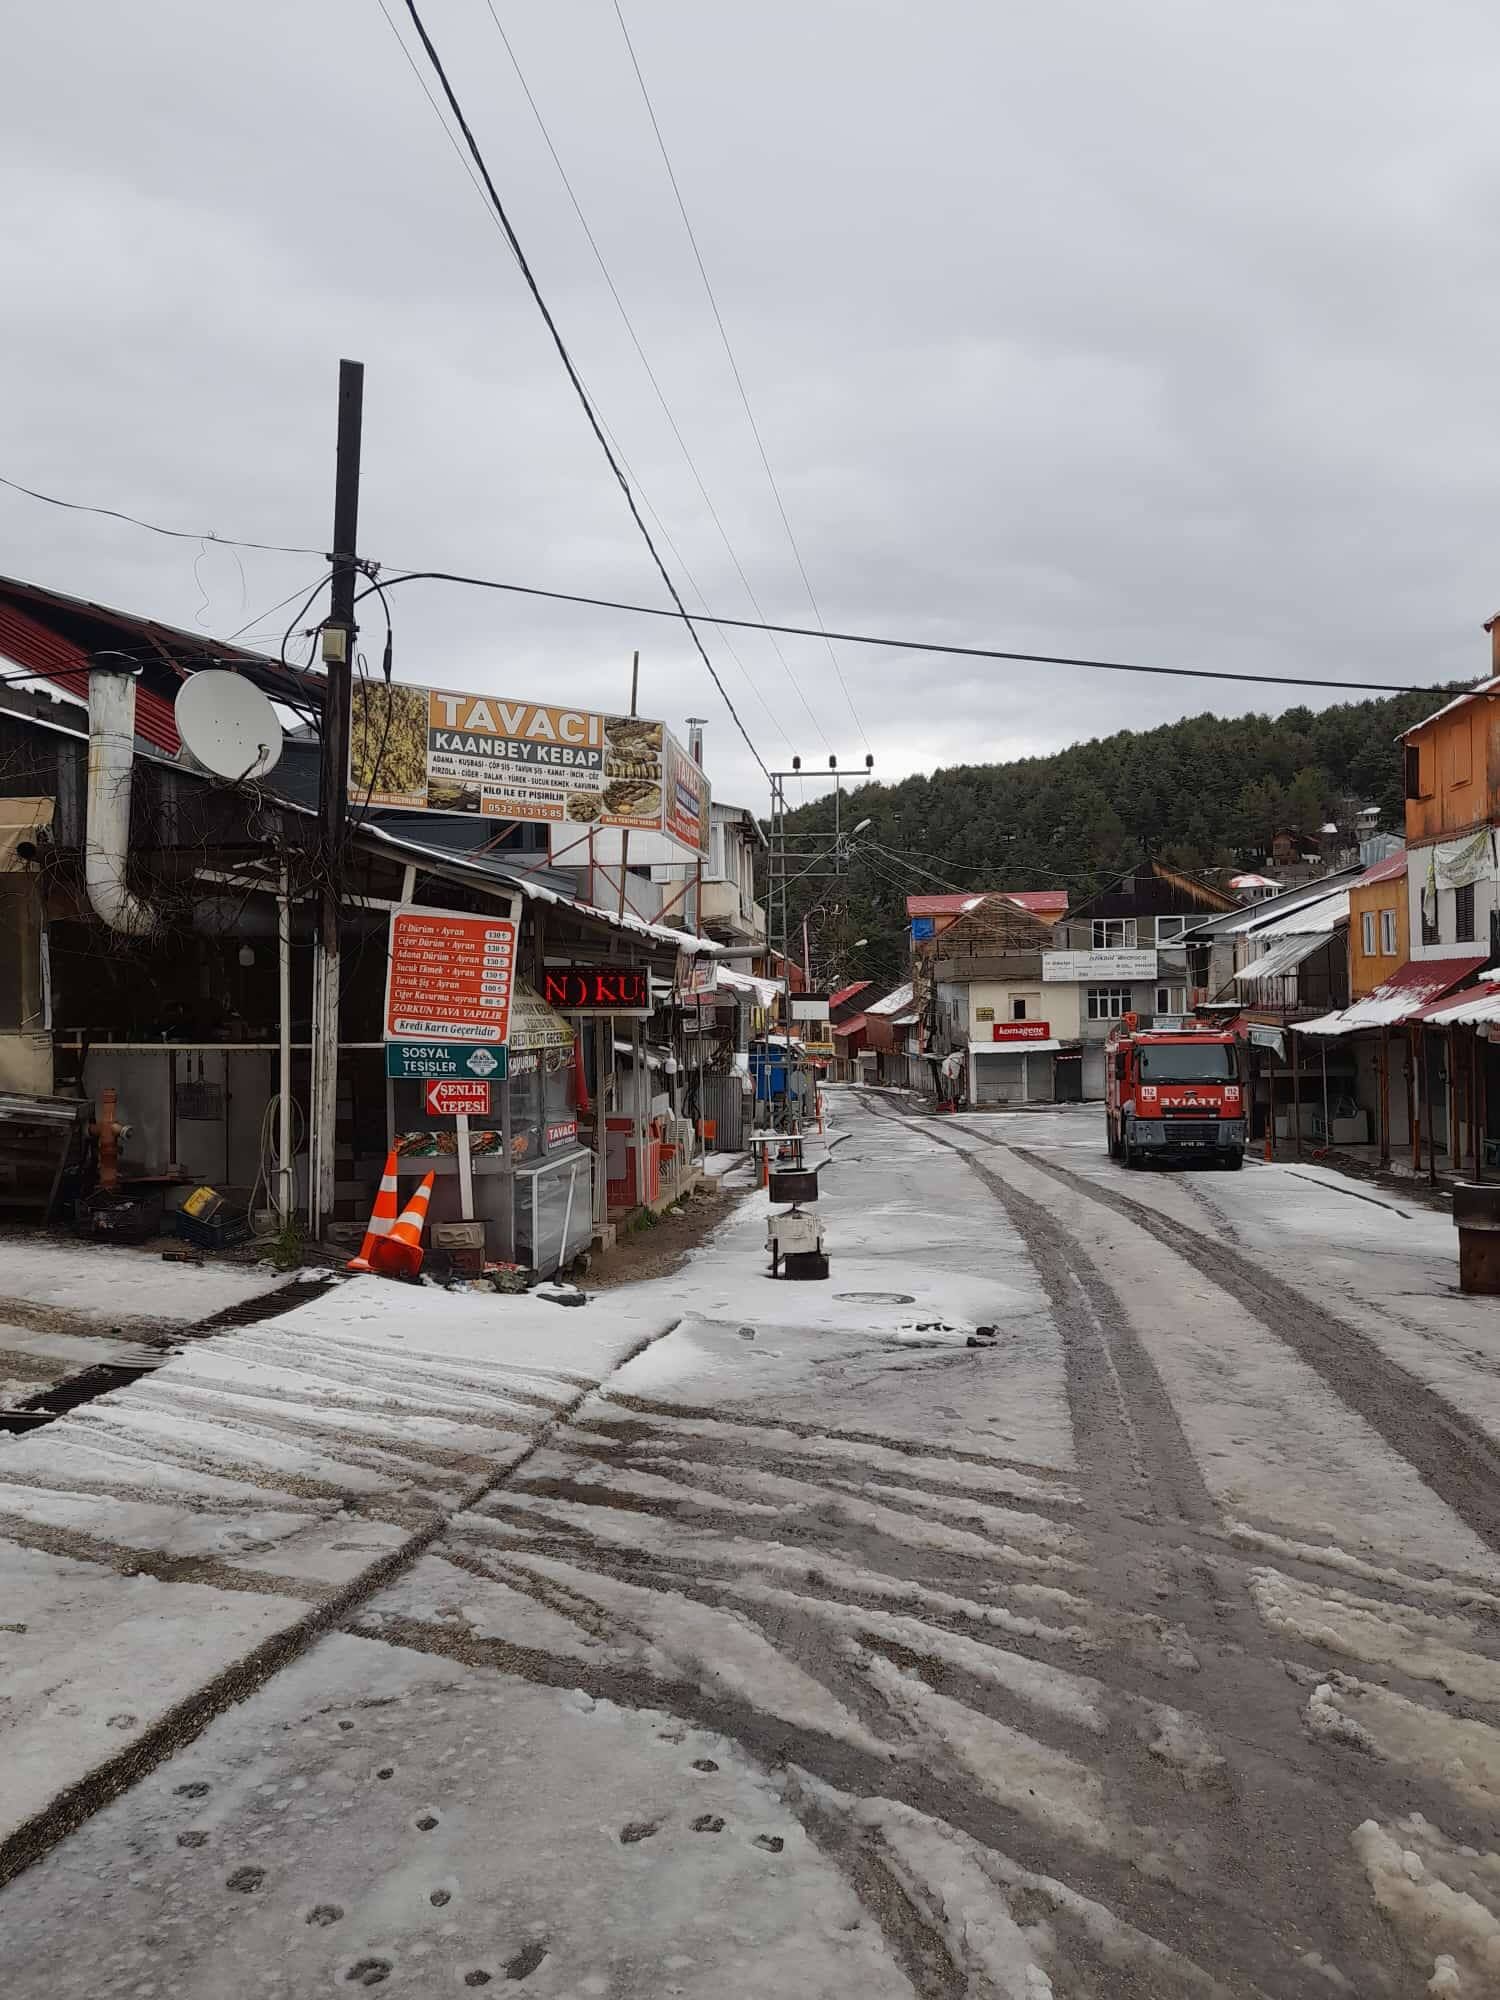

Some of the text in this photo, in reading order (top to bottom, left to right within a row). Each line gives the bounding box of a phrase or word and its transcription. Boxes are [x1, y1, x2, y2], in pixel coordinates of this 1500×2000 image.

[437, 694, 599, 745] TAVACI
[435, 733, 600, 768] KAANBEY KEBAP
[517, 789, 527, 798] ET
[488, 804, 562, 818] 0532 113 15 85
[407, 924, 434, 934] Dürüm
[440, 926, 465, 937] Ayran
[418, 938, 445, 948] Dürüm
[451, 940, 475, 951] Ayran
[422, 951, 449, 961] Dürüm
[455, 954, 480, 964] Ayran
[396, 962, 418, 972] Sucuk
[419, 964, 444, 974] Ekmek
[451, 967, 475, 978] Ayran
[395, 975, 418, 985] Tavuk
[436, 979, 460, 990] Ayran
[414, 990, 450, 1002] Kavurma
[393, 1003, 502, 1020] ZORKUN TAVA YAPILIR
[399, 1019, 496, 1038] Kredi Kartı Geçerlidir
[998, 1026, 1044, 1037] komagene
[402, 1047, 451, 1059] SOSYAL
[403, 1059, 457, 1072] TESİSLER
[440, 1082, 486, 1098] ŞENLİK
[1143, 1088, 1154, 1096] 112
[1226, 1087, 1237, 1095] 112
[440, 1100, 486, 1113] TEPESİ
[549, 1123, 576, 1140] TAVACI
